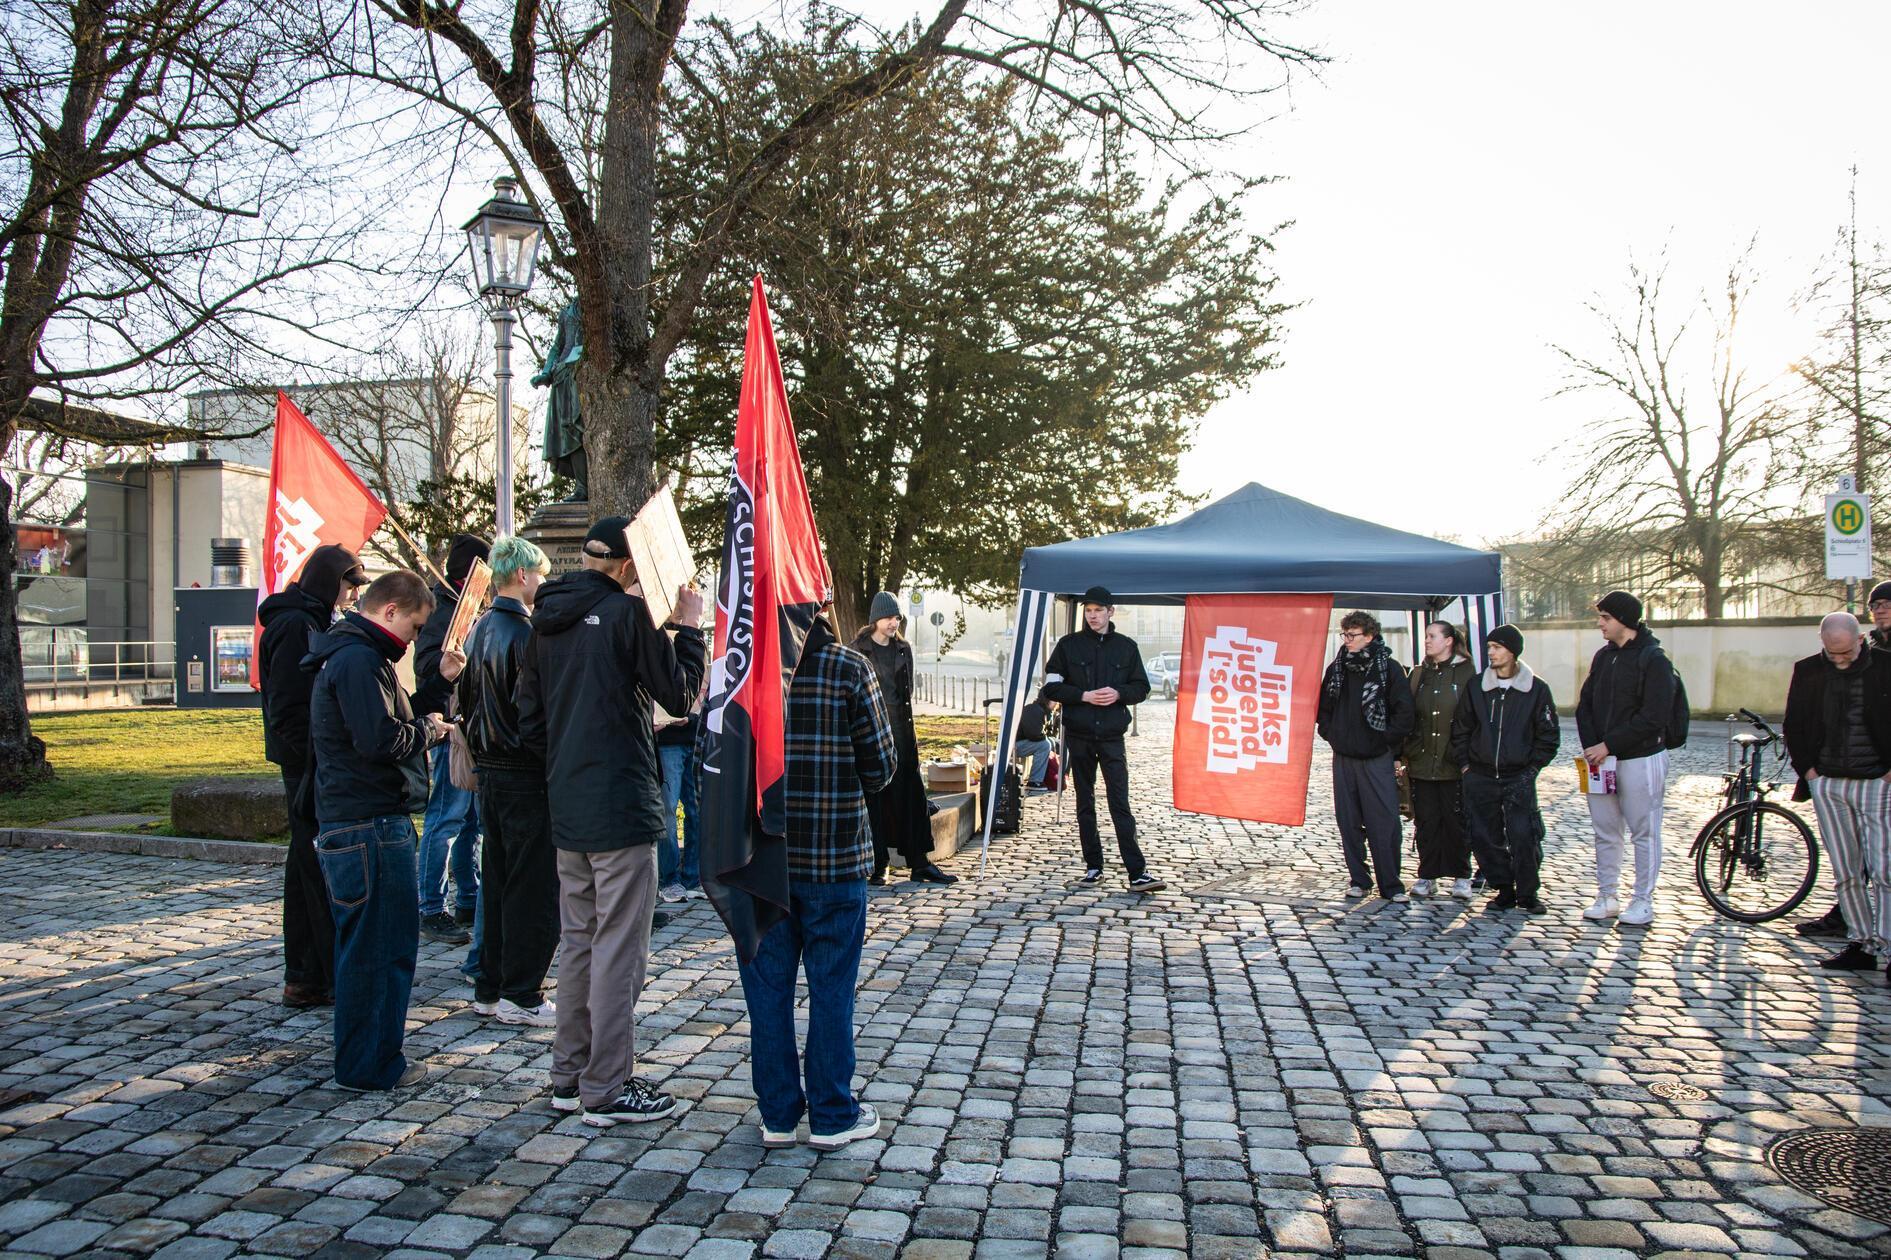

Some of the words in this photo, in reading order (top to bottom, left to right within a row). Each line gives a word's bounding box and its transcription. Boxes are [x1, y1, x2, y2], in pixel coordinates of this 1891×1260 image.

[1842, 478, 1851, 490] 6
[1840, 507, 1856, 528] H
[1229, 640, 1267, 757] jugend
[1260, 671, 1287, 747] links
